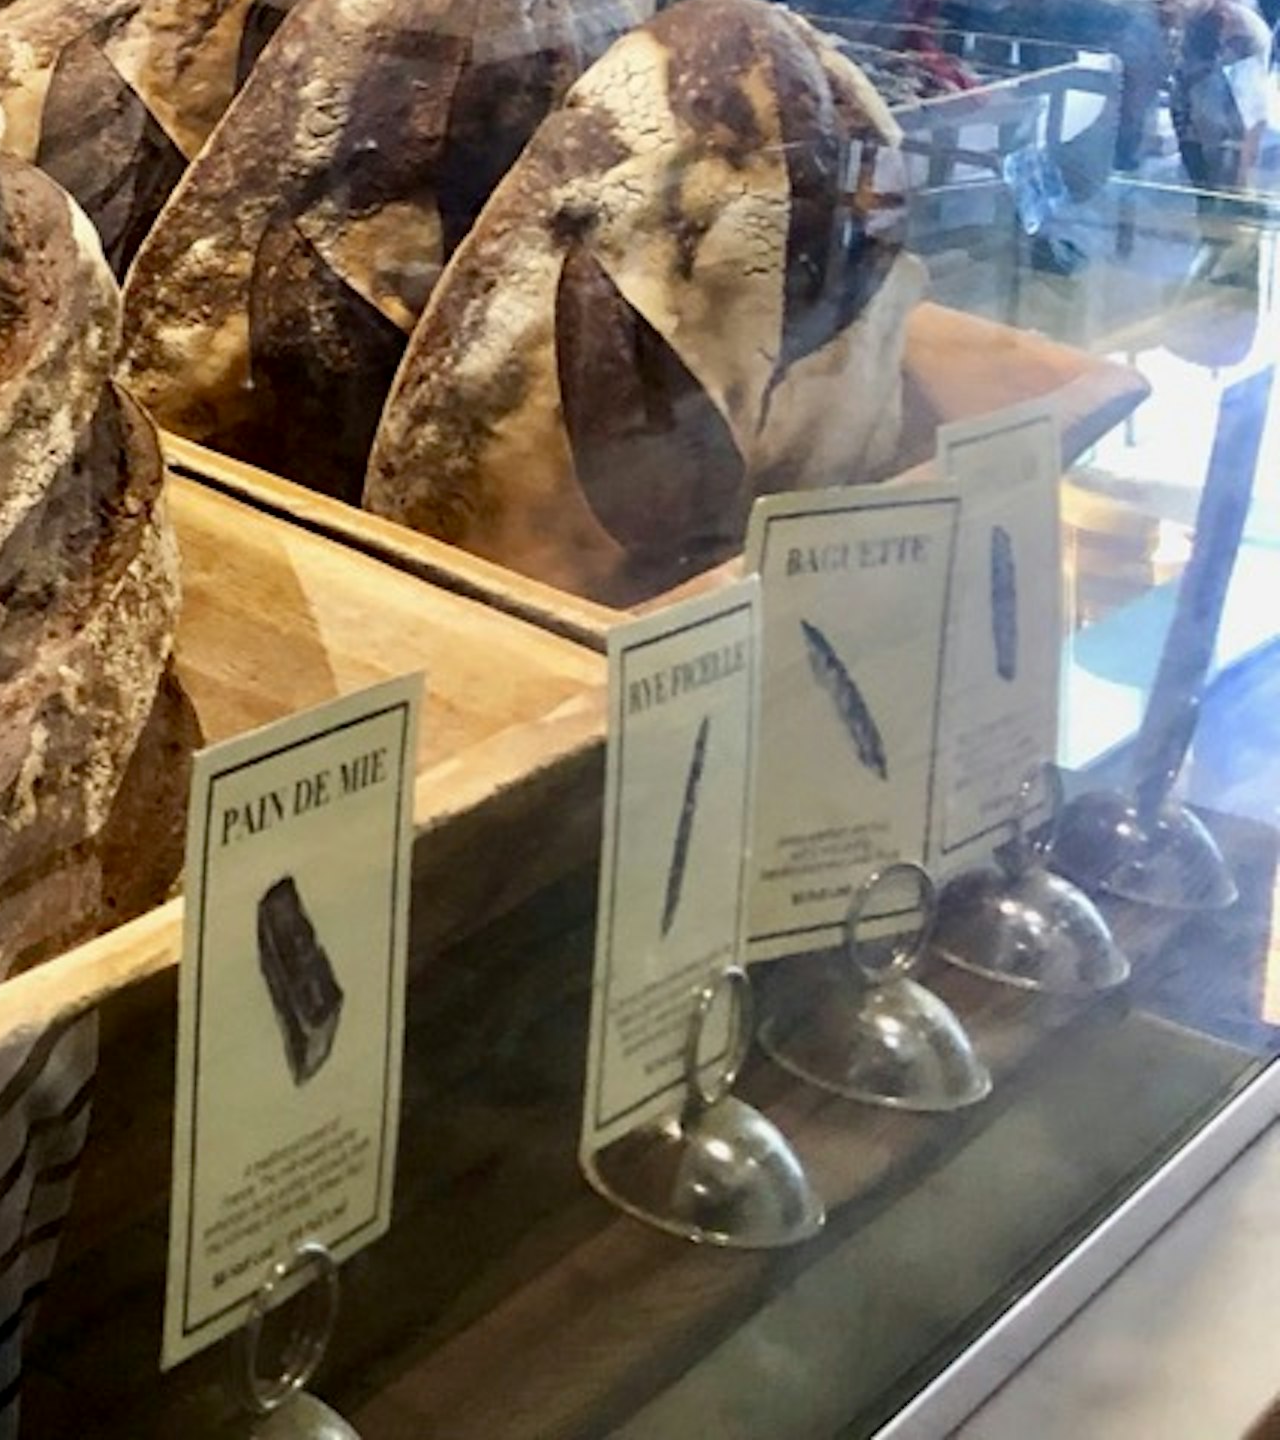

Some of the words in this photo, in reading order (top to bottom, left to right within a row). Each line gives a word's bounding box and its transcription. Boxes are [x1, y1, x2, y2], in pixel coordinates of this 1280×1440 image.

[786, 533, 927, 576] BAGUETTE
[628, 674, 664, 717] RYE
[220, 791, 286, 847] PAIN
[293, 769, 332, 817] DE
[338, 746, 390, 796] MIE
